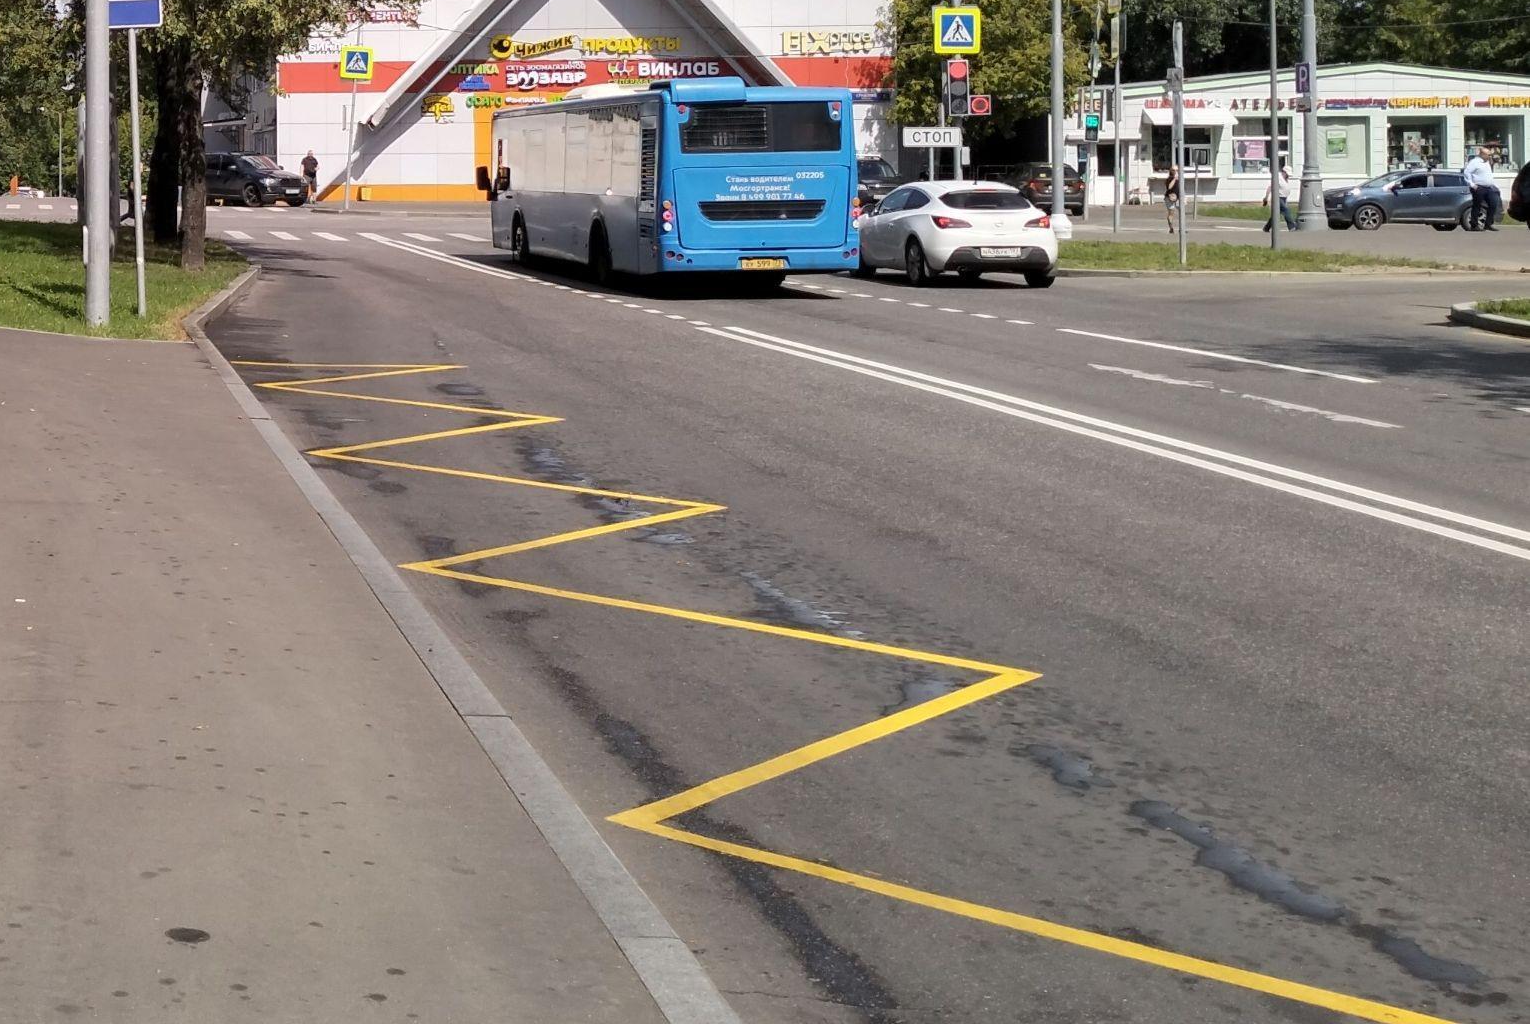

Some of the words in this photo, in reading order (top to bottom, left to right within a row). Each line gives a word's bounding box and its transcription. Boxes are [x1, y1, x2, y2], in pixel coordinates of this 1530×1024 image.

[515, 34, 574, 56] ЧИЖИК
[582, 36, 681, 53] ПРОДУКТЫ
[450, 63, 500, 75] ОПТИКА
[638, 61, 720, 76] ВИНЛАБ
[912, 131, 952, 143] СТОП
[725, 175, 749, 183] Стань
[750, 175, 794, 183] водителем
